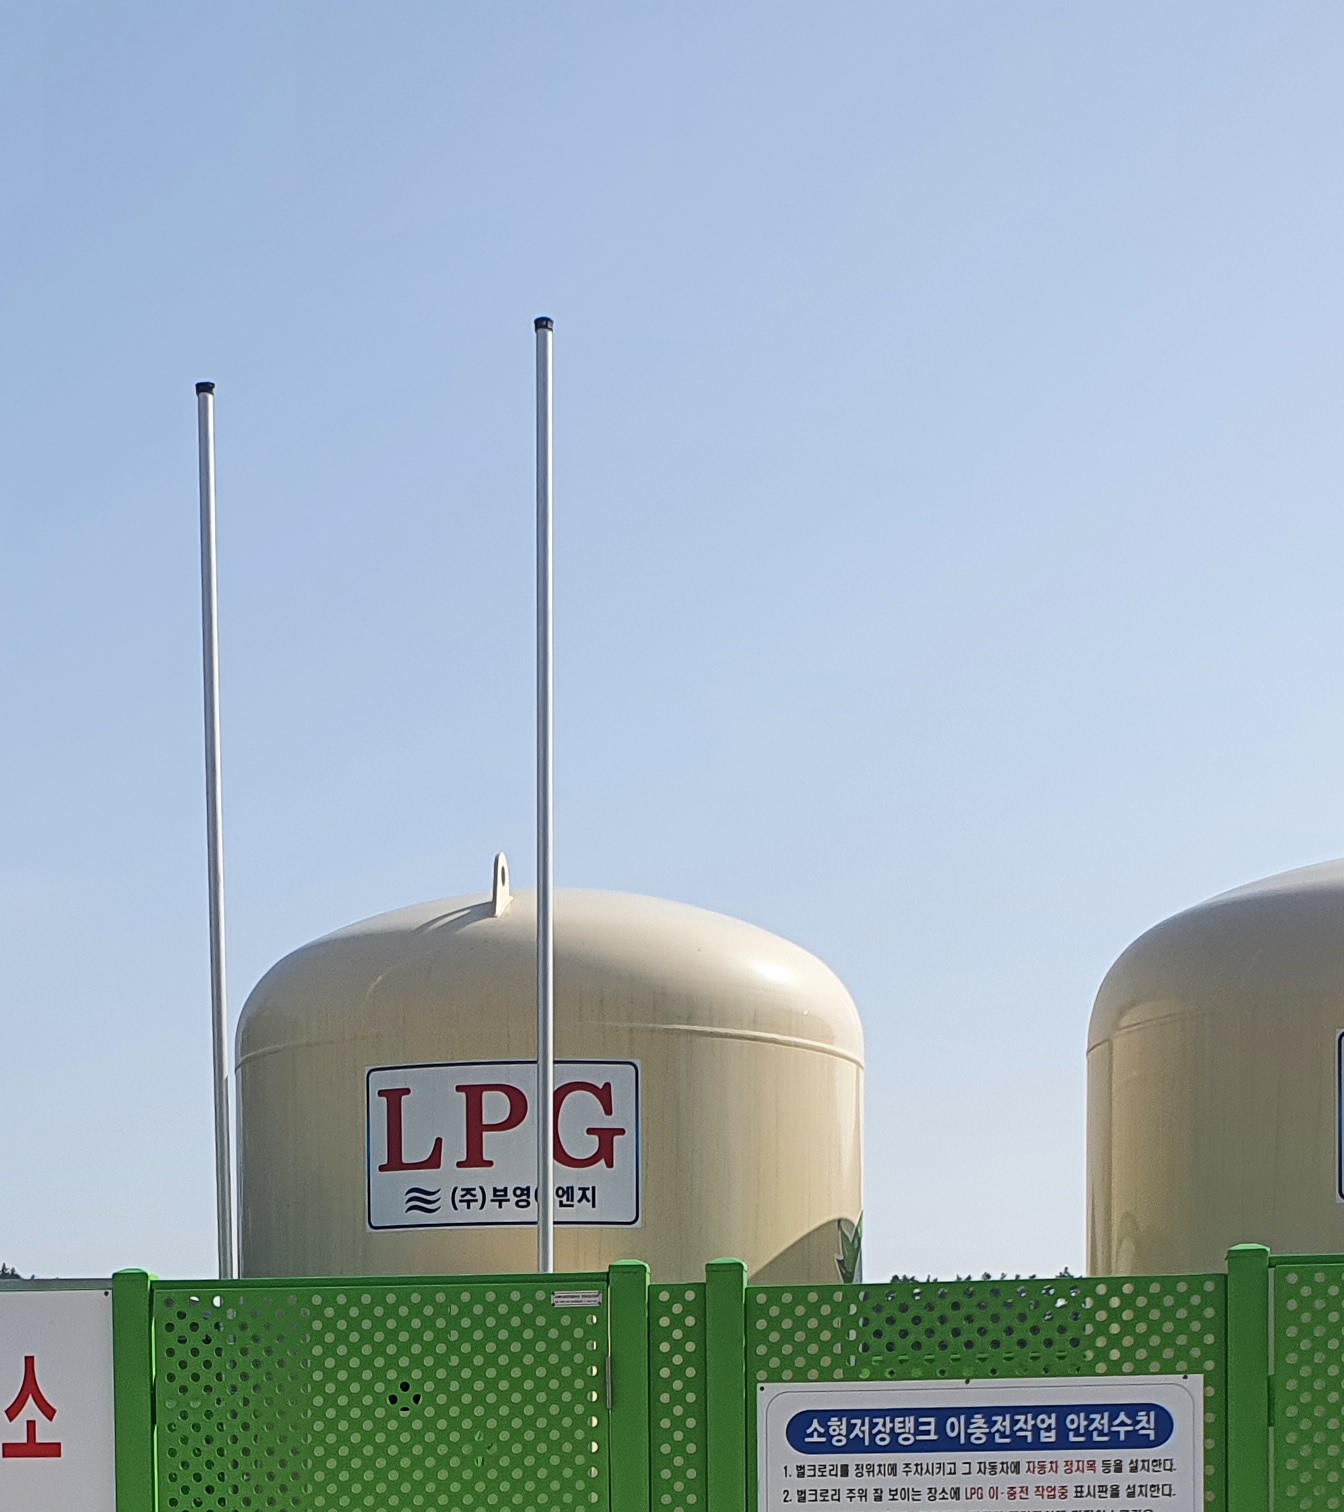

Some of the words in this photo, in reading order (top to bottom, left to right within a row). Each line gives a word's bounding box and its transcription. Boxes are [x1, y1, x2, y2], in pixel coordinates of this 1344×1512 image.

[377, 1081, 626, 1172] LPG
[451, 1185, 597, 1211] (주)부영엔지
[804, 1415, 938, 1447] 소형저장탱크
[945, 1412, 1057, 1445] 이충전작업
[1065, 1410, 1156, 1442] 안전수칙
[783, 1464, 792, 1478] 1.
[795, 1463, 849, 1478] 벌크로리를
[854, 1462, 897, 1478] 정위치에
[901, 1461, 956, 1477] 주차시키고
[961, 1461, 972, 1475] 그
[976, 1460, 1020, 1476] 자동차에
[1025, 1460, 1059, 1475] 자동차
[1063, 1459, 1096, 1474] 정지목
[1101, 1458, 1123, 1474] 등을
[1128, 1457, 1176, 1473] 설치한다.
[782, 1489, 792, 1502] 2.
[796, 1488, 840, 1503] 벌크로리
[845, 1487, 868, 1503] 주위
[872, 1487, 883, 1502] 잘
[887, 1487, 922, 1502] 보이는
[926, 1486, 960, 1501] 장소에
[964, 1486, 983, 1500] LPG
[1033, 1485, 1068, 1500] 작업중
[1072, 1483, 1120, 1499] 표시판을
[1125, 1483, 1176, 1498] 설치한다.
